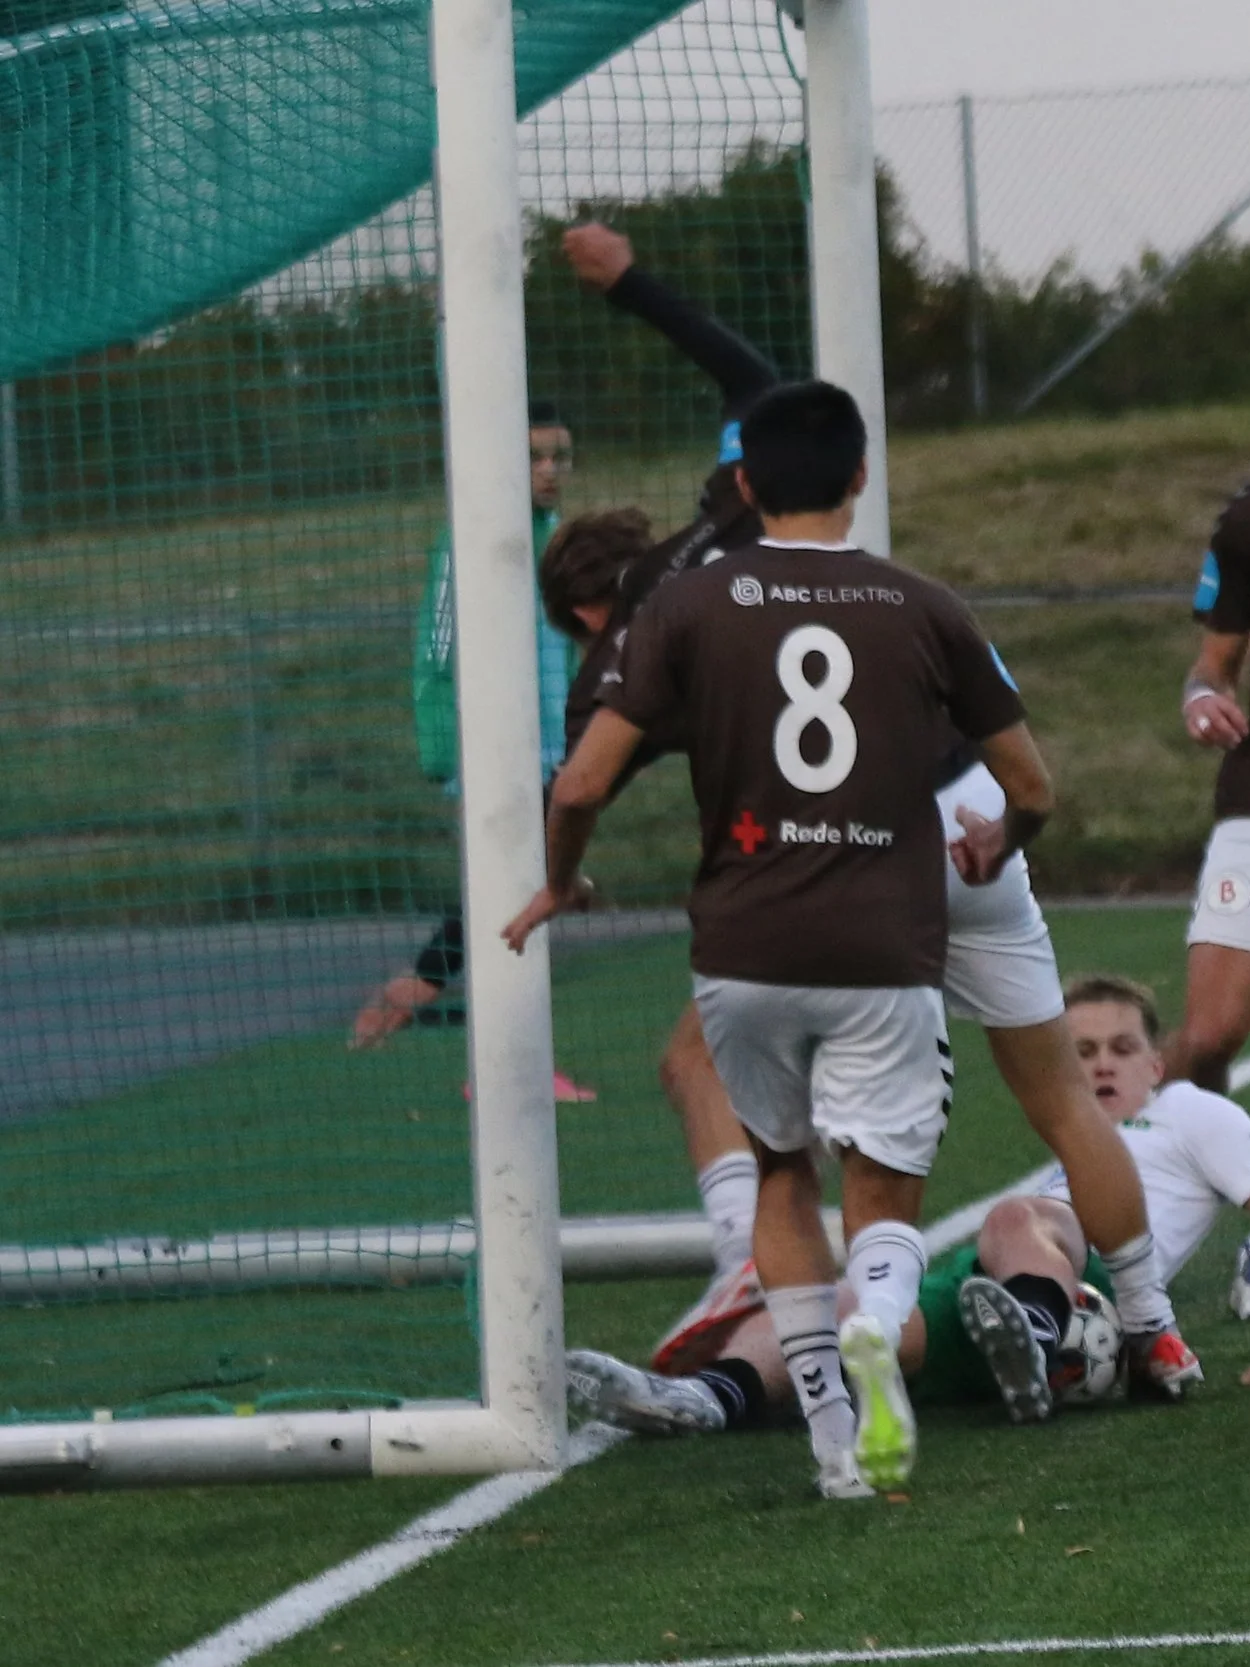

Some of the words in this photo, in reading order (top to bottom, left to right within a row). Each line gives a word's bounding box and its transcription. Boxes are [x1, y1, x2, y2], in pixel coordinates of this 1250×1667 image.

[769, 587, 812, 603] ABC
[816, 588, 905, 605] ELEKTRO
[772, 623, 858, 794] 8
[780, 821, 842, 844] Røde
[847, 822, 894, 846] Kors
[1219, 879, 1237, 904] B
